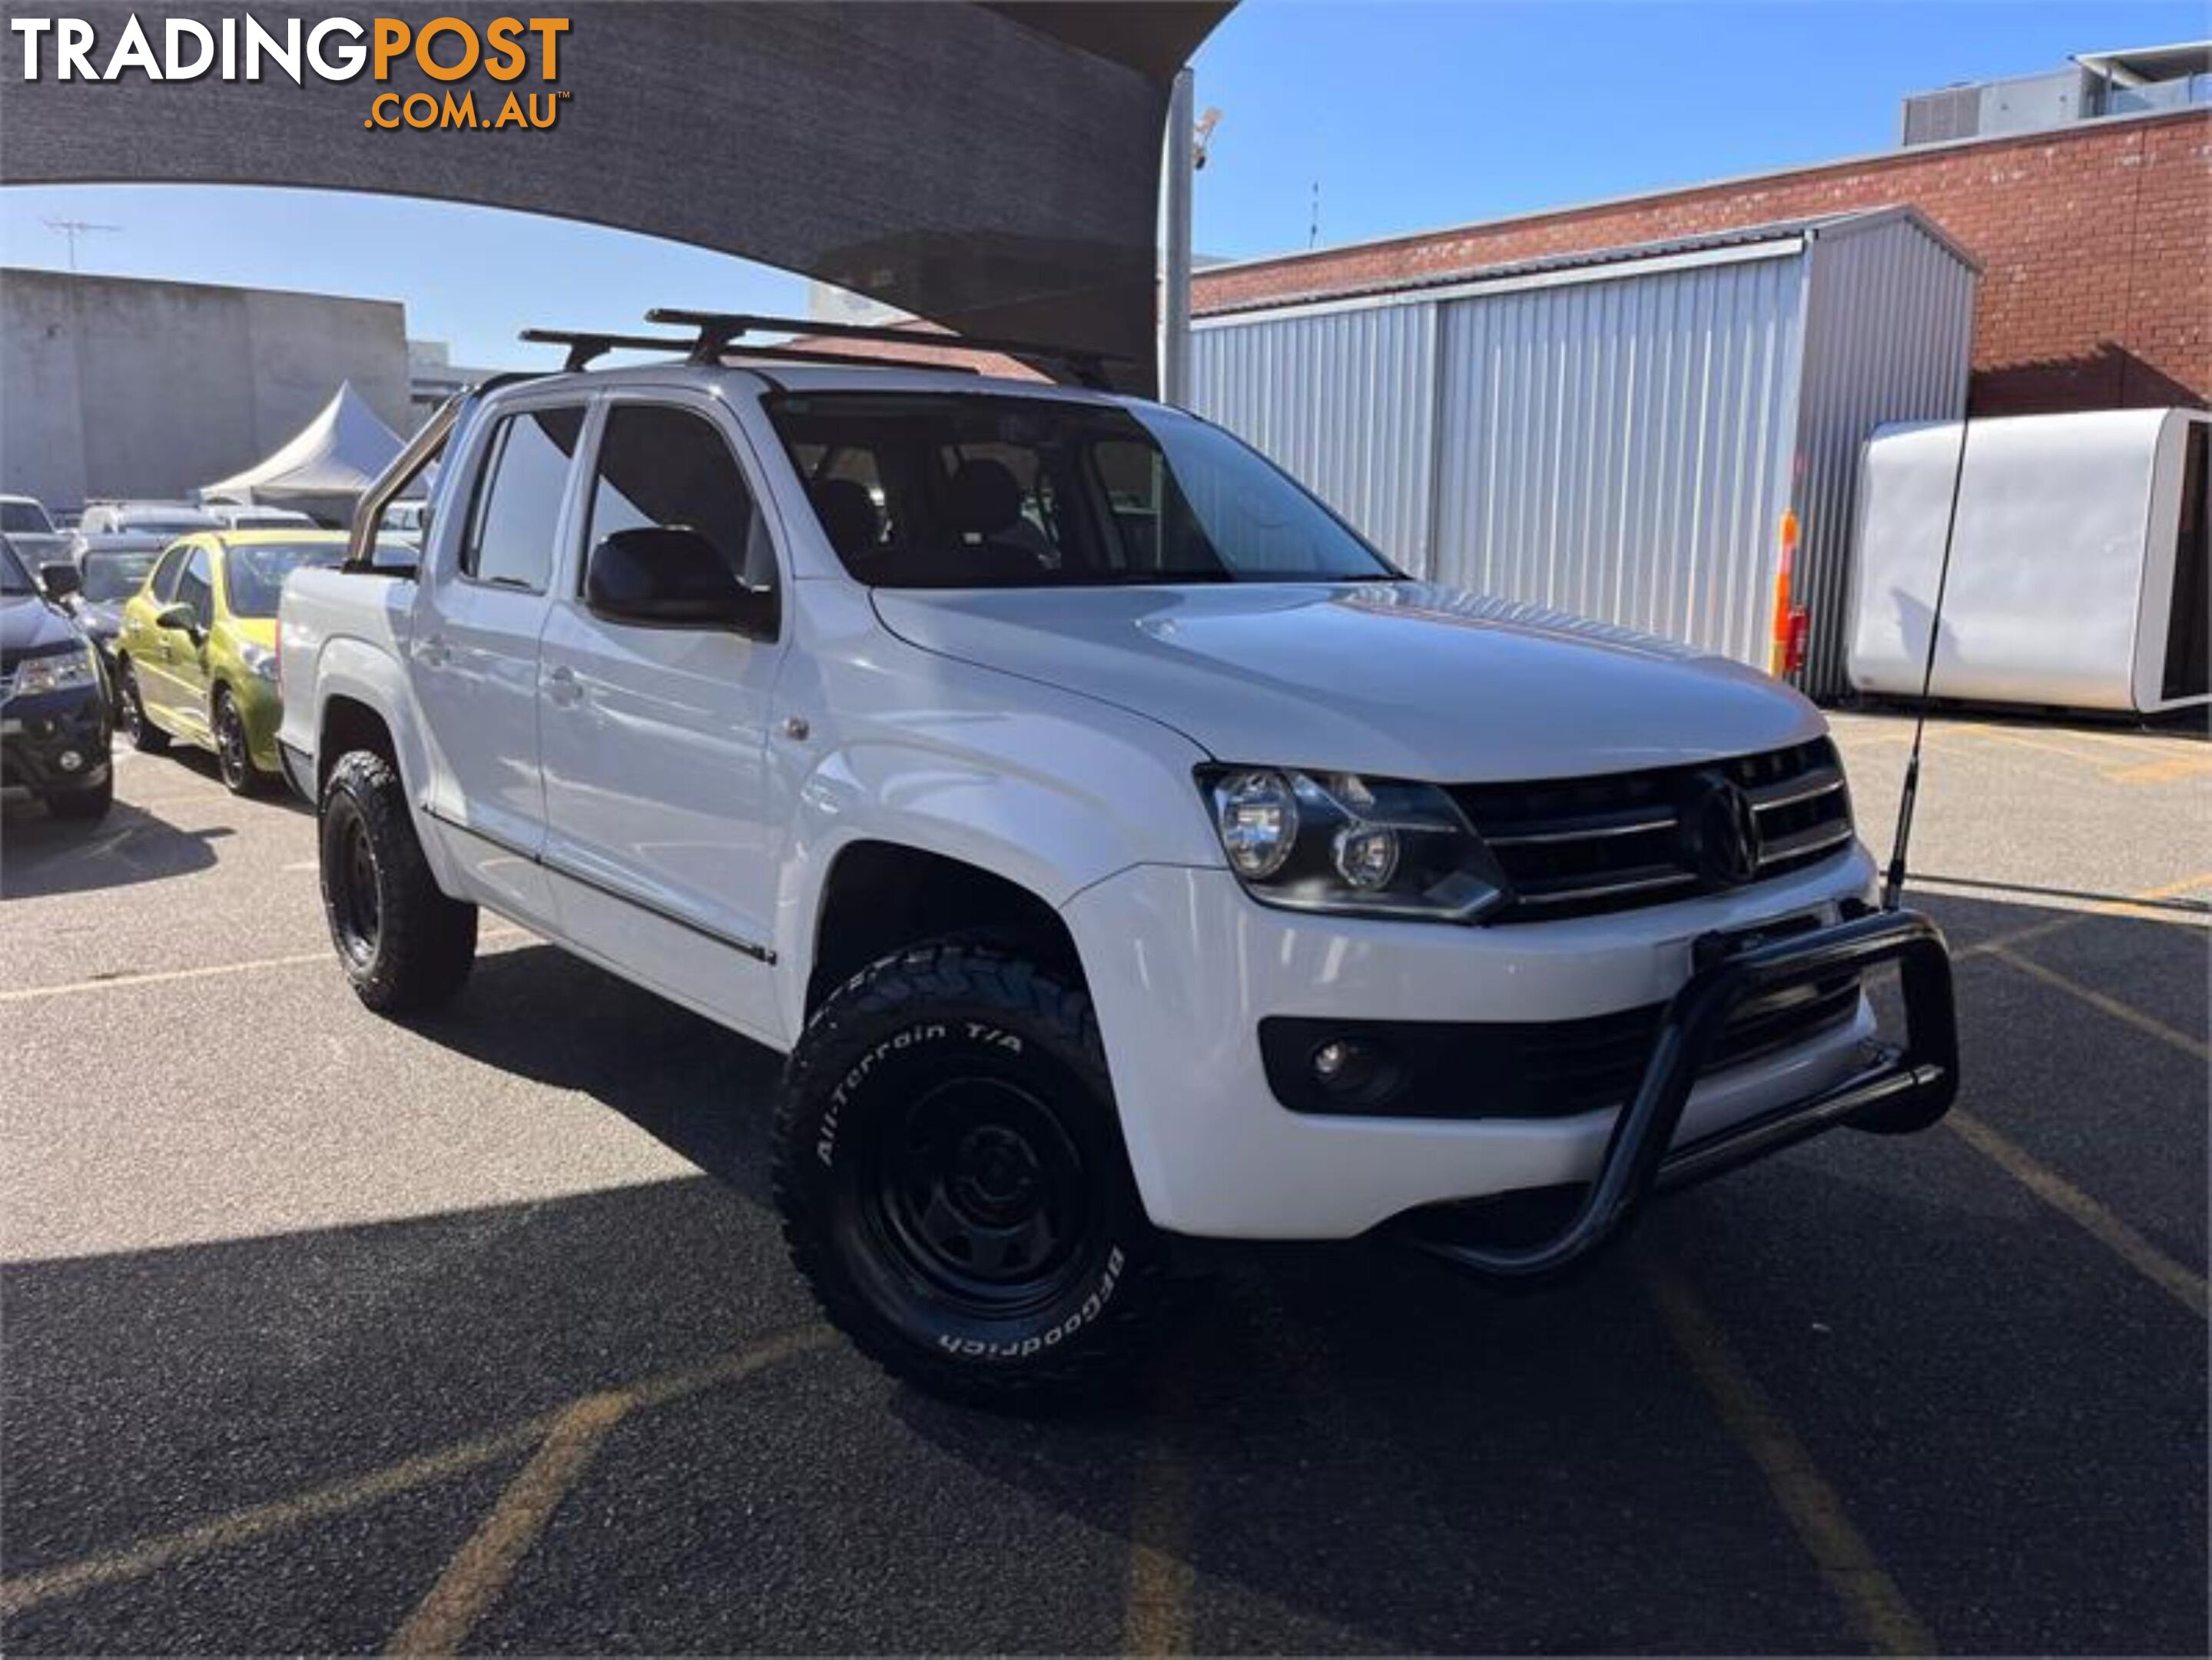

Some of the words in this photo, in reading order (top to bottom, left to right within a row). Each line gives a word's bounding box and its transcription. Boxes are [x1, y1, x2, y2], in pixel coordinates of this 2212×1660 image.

[817, 1023, 947, 1167] All-Terrain
[967, 1024, 1023, 1053] T/A
[937, 1247, 1125, 1359] BFGoodrich
